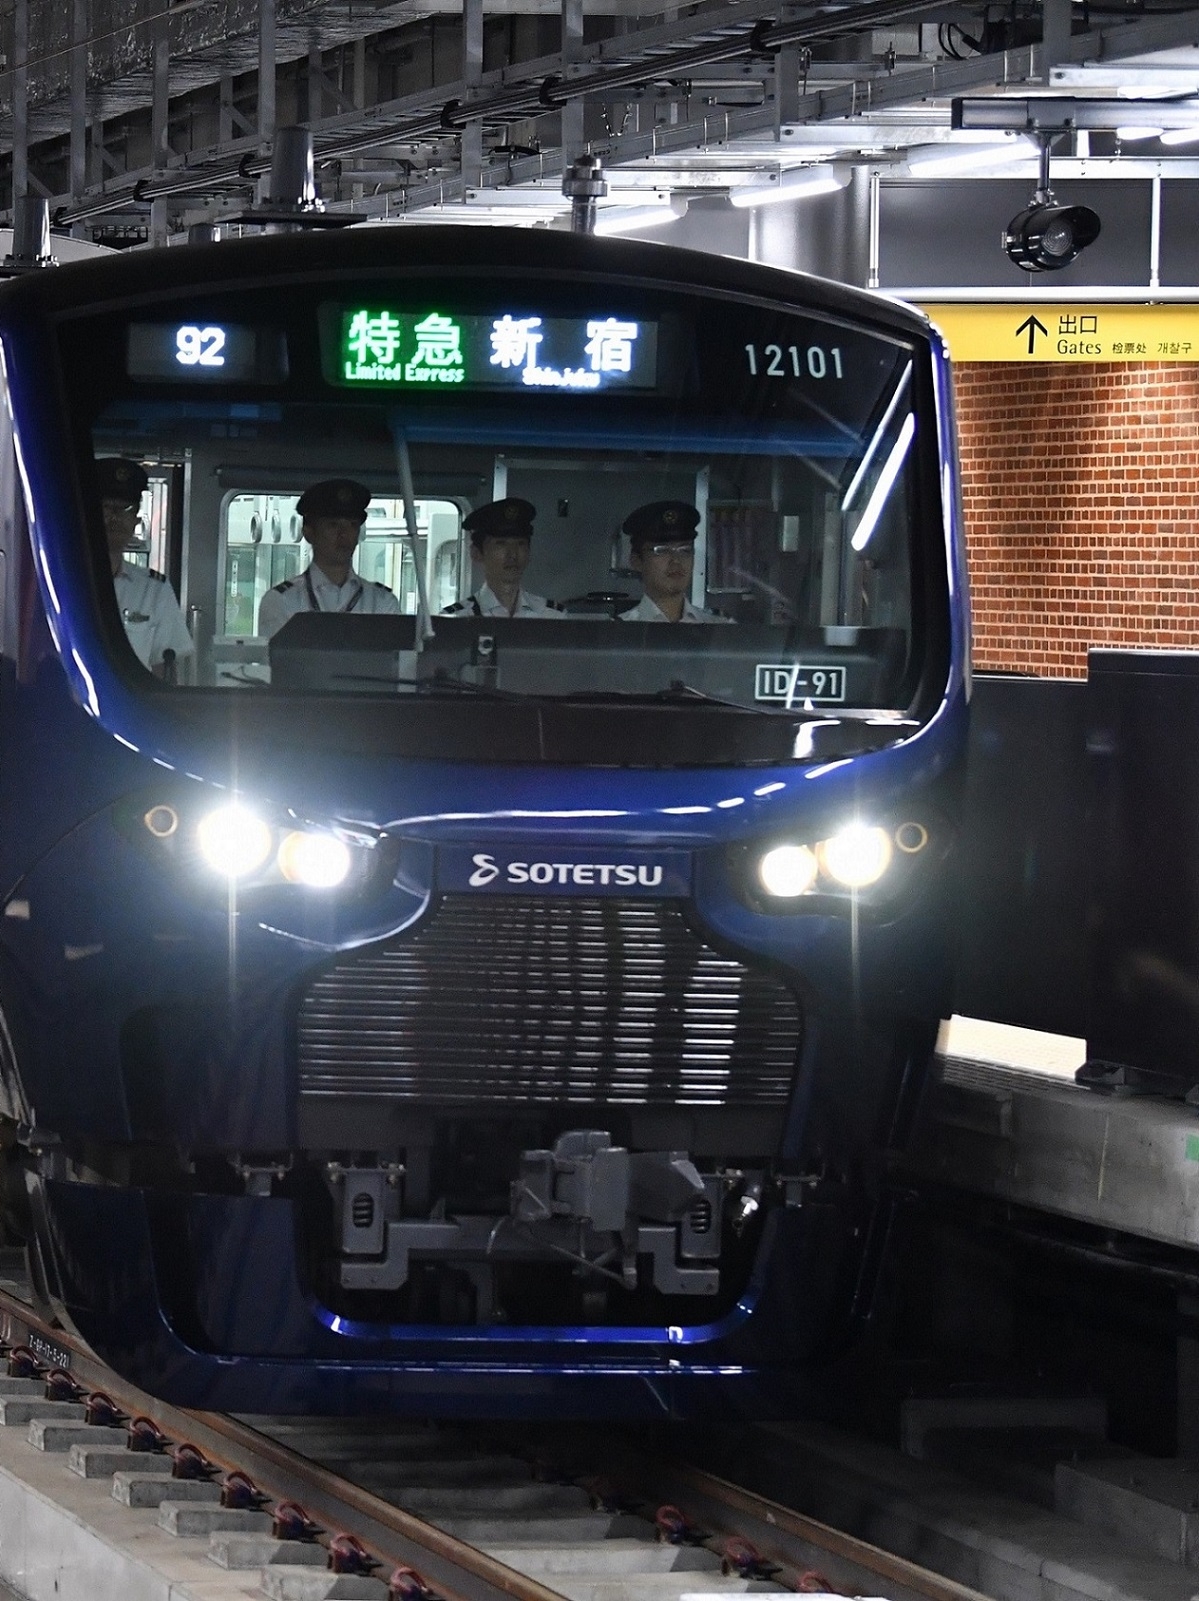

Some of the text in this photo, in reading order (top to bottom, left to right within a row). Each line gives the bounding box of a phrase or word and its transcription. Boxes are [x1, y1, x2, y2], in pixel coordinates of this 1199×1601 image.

[1058, 314, 1098, 335] 出口
[174, 326, 226, 367] 92
[348, 310, 638, 372] 特急 新宿
[1057, 339, 1102, 355] Gates
[1112, 342, 1147, 355] 检票处
[1157, 342, 1193, 355] 개찰구
[345, 361, 401, 381] Limited
[744, 342, 845, 380] 12101
[764, 670, 838, 696] ID-91
[506, 862, 663, 887] SOTETSU
